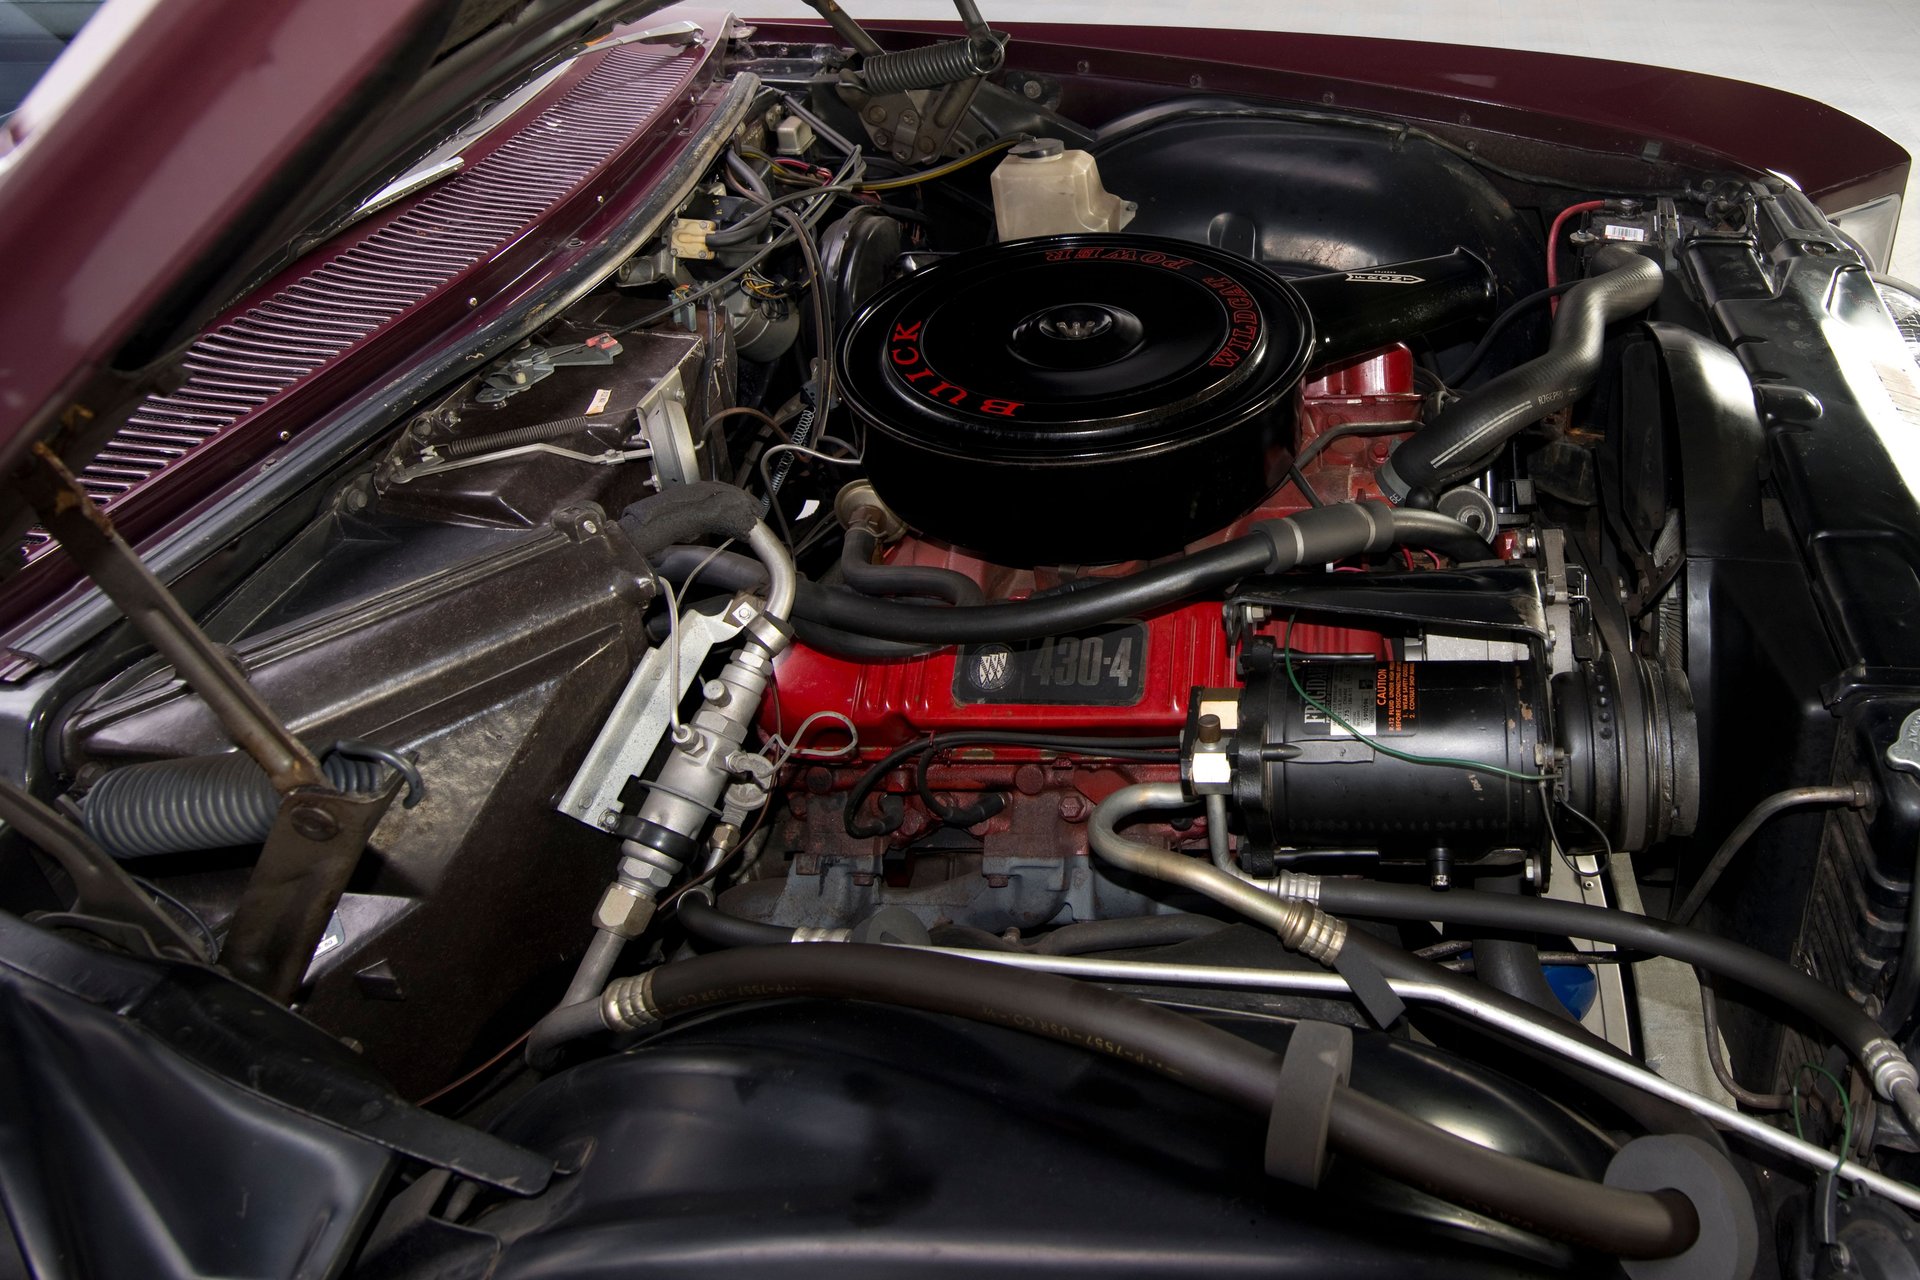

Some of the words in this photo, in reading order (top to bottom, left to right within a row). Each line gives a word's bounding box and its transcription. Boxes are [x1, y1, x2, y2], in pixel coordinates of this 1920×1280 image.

[1045, 247, 1195, 271] POWER
[1203, 275, 1258, 369] WILDCAT
[891, 320, 1026, 418] BUICK
[1032, 636, 1133, 687] 430-4
[1376, 669, 1387, 706] CAUTION
